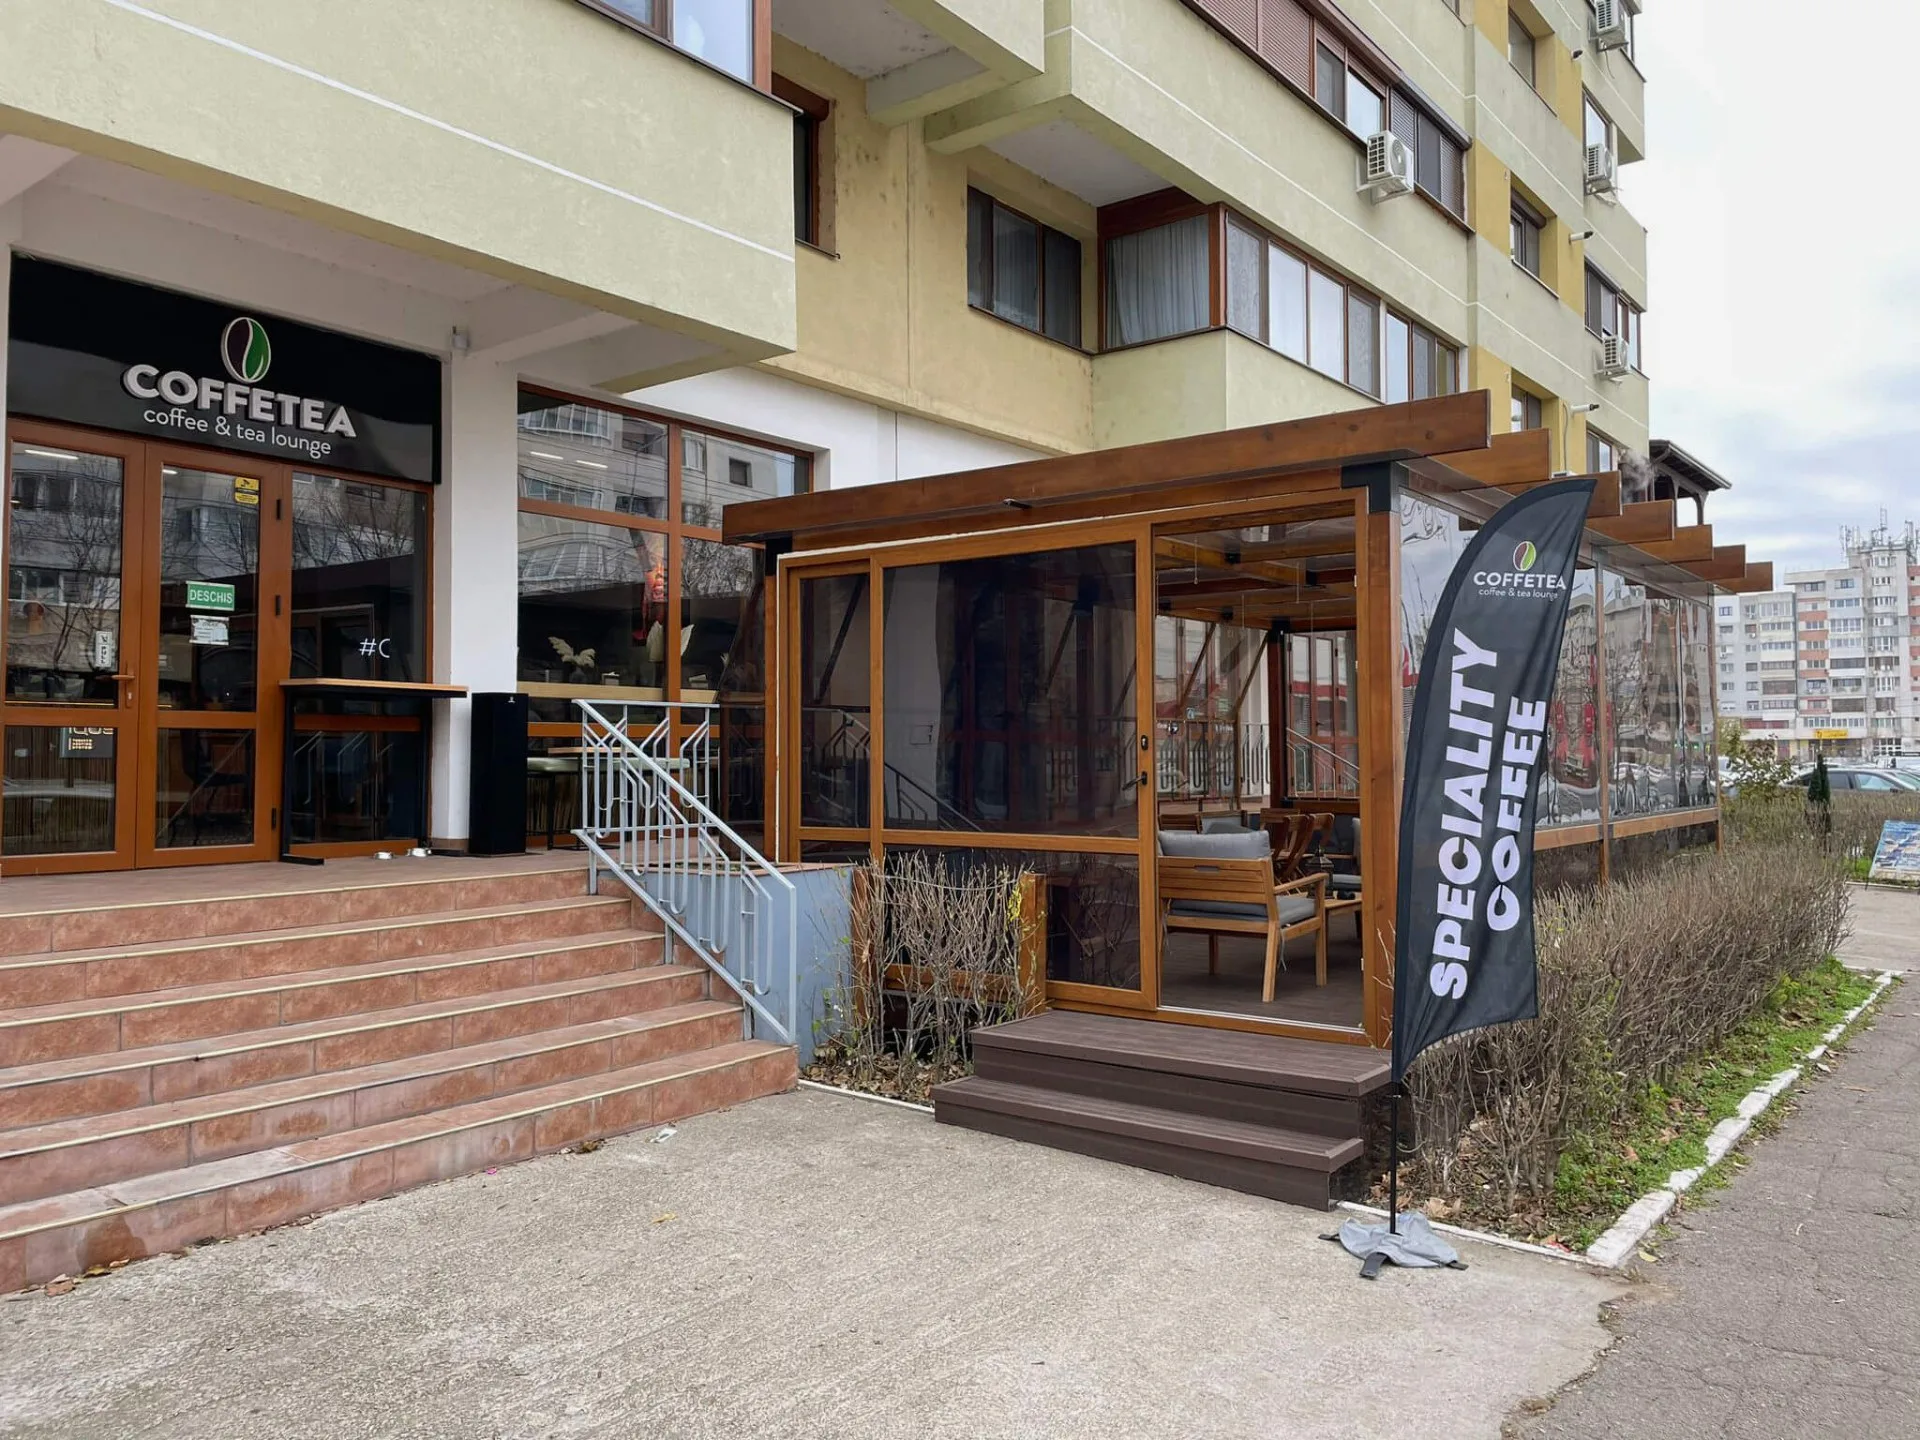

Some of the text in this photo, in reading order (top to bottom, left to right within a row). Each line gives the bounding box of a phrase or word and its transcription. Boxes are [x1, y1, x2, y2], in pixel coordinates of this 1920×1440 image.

[122, 364, 357, 438] COFFETEA
[143, 407, 331, 459] coffee & tea lounge
[189, 589, 233, 604] DESCHIS
[1473, 571, 1567, 591] COFFETEA
[1478, 586, 1506, 597] coffee
[1507, 587, 1516, 597] &
[1517, 588, 1531, 598] tea
[1430, 627, 1498, 1000] SPECIALITY
[1487, 696, 1547, 931] COFFEE
